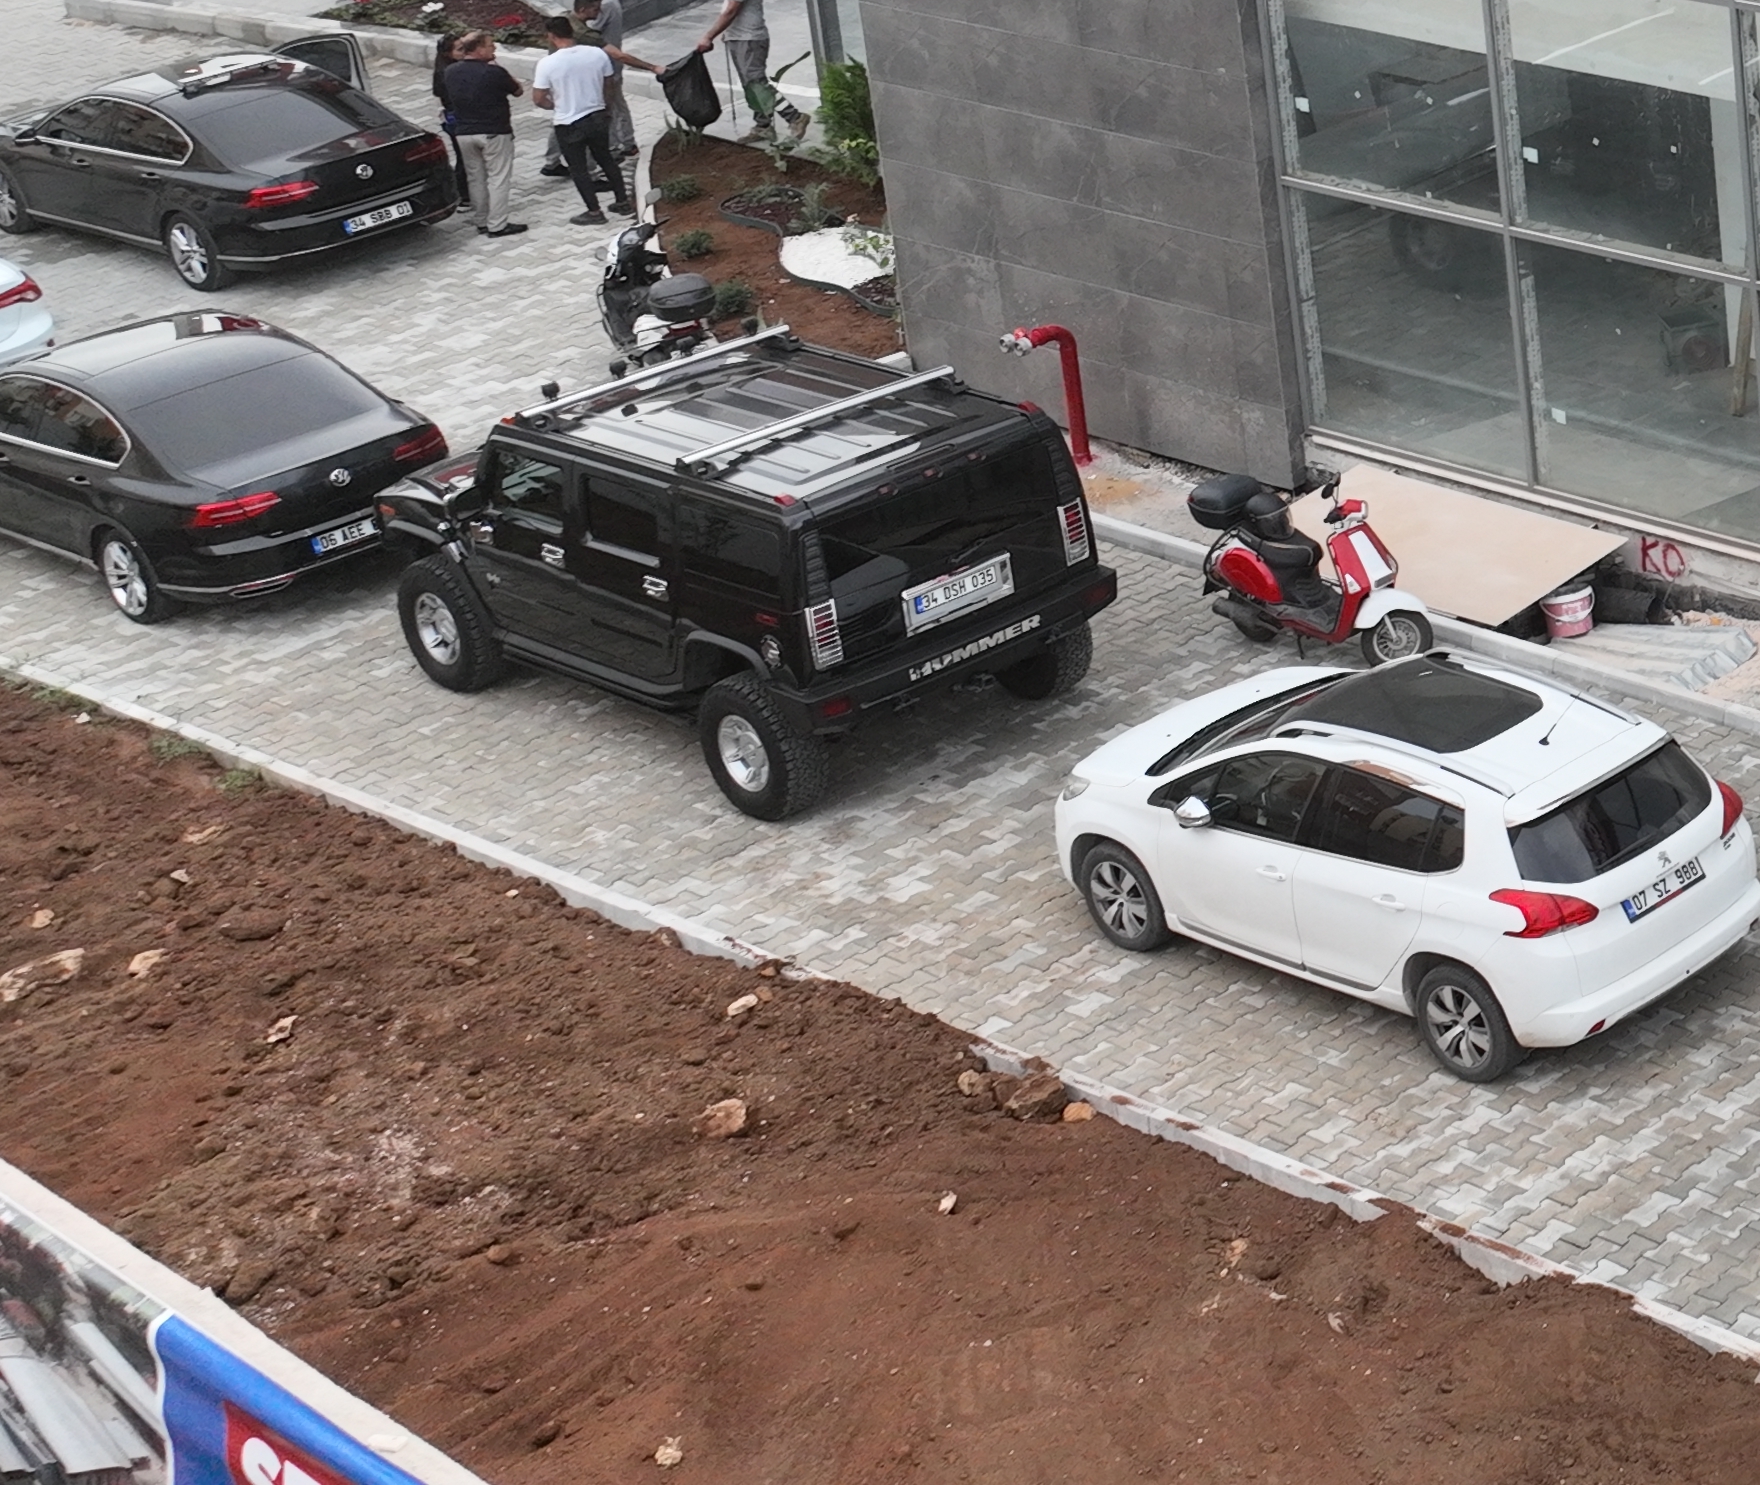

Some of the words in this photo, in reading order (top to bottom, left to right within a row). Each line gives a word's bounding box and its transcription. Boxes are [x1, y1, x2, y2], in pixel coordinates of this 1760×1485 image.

[350, 217, 367, 230] 34
[319, 533, 338, 549] 06
[1640, 535, 1686, 578] KO
[922, 592, 939, 609] 34
[943, 580, 967, 601] DSH
[971, 568, 994, 588] 035
[908, 614, 1041, 682] HUMMER
[1631, 890, 1648, 911] 07
[1652, 878, 1671, 898] SZ
[1674, 860, 1699, 885] 988
